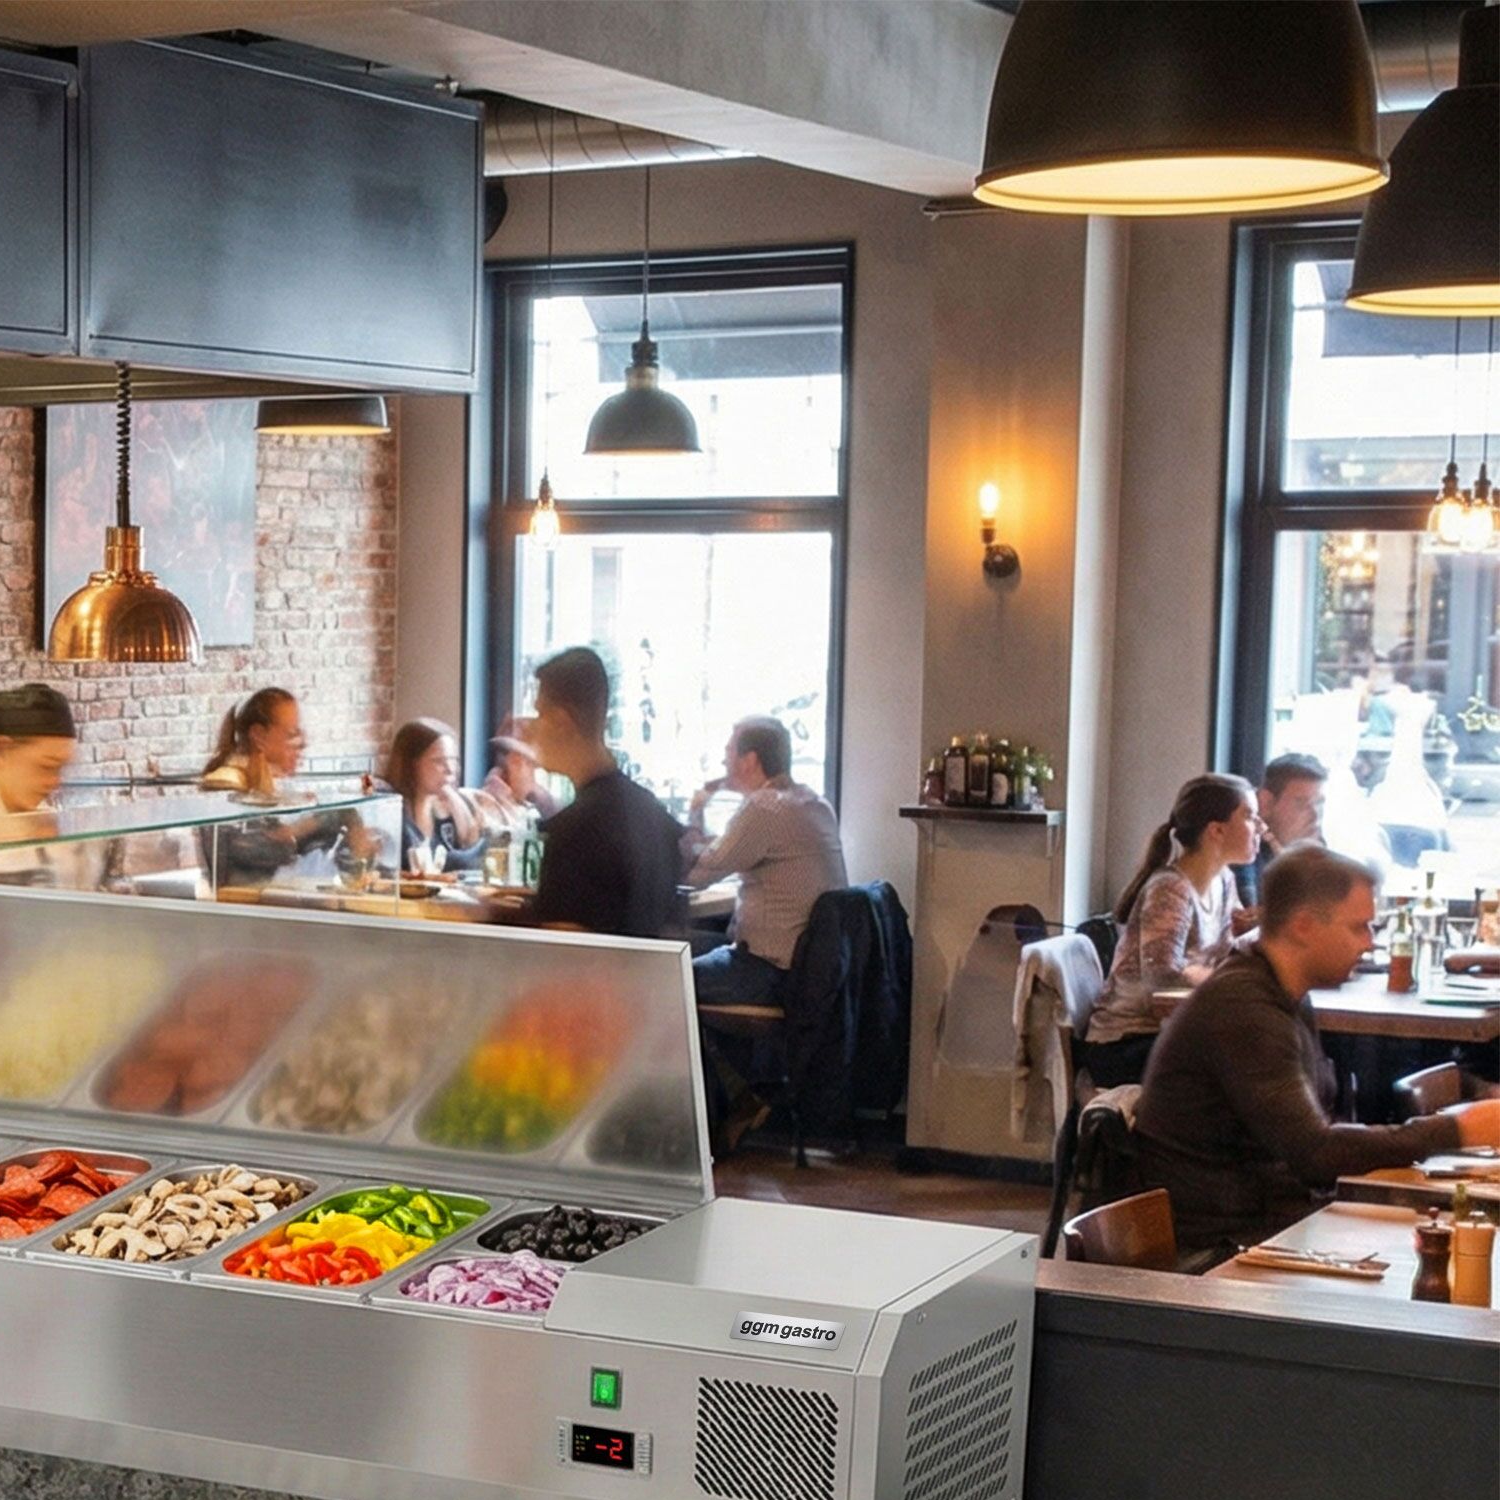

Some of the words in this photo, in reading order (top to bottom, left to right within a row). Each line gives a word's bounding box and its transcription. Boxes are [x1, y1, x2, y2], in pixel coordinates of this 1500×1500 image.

[740, 1320, 779, 1336] ggm
[779, 1325, 836, 1341] gastro
[595, 1438, 623, 1460] -2
